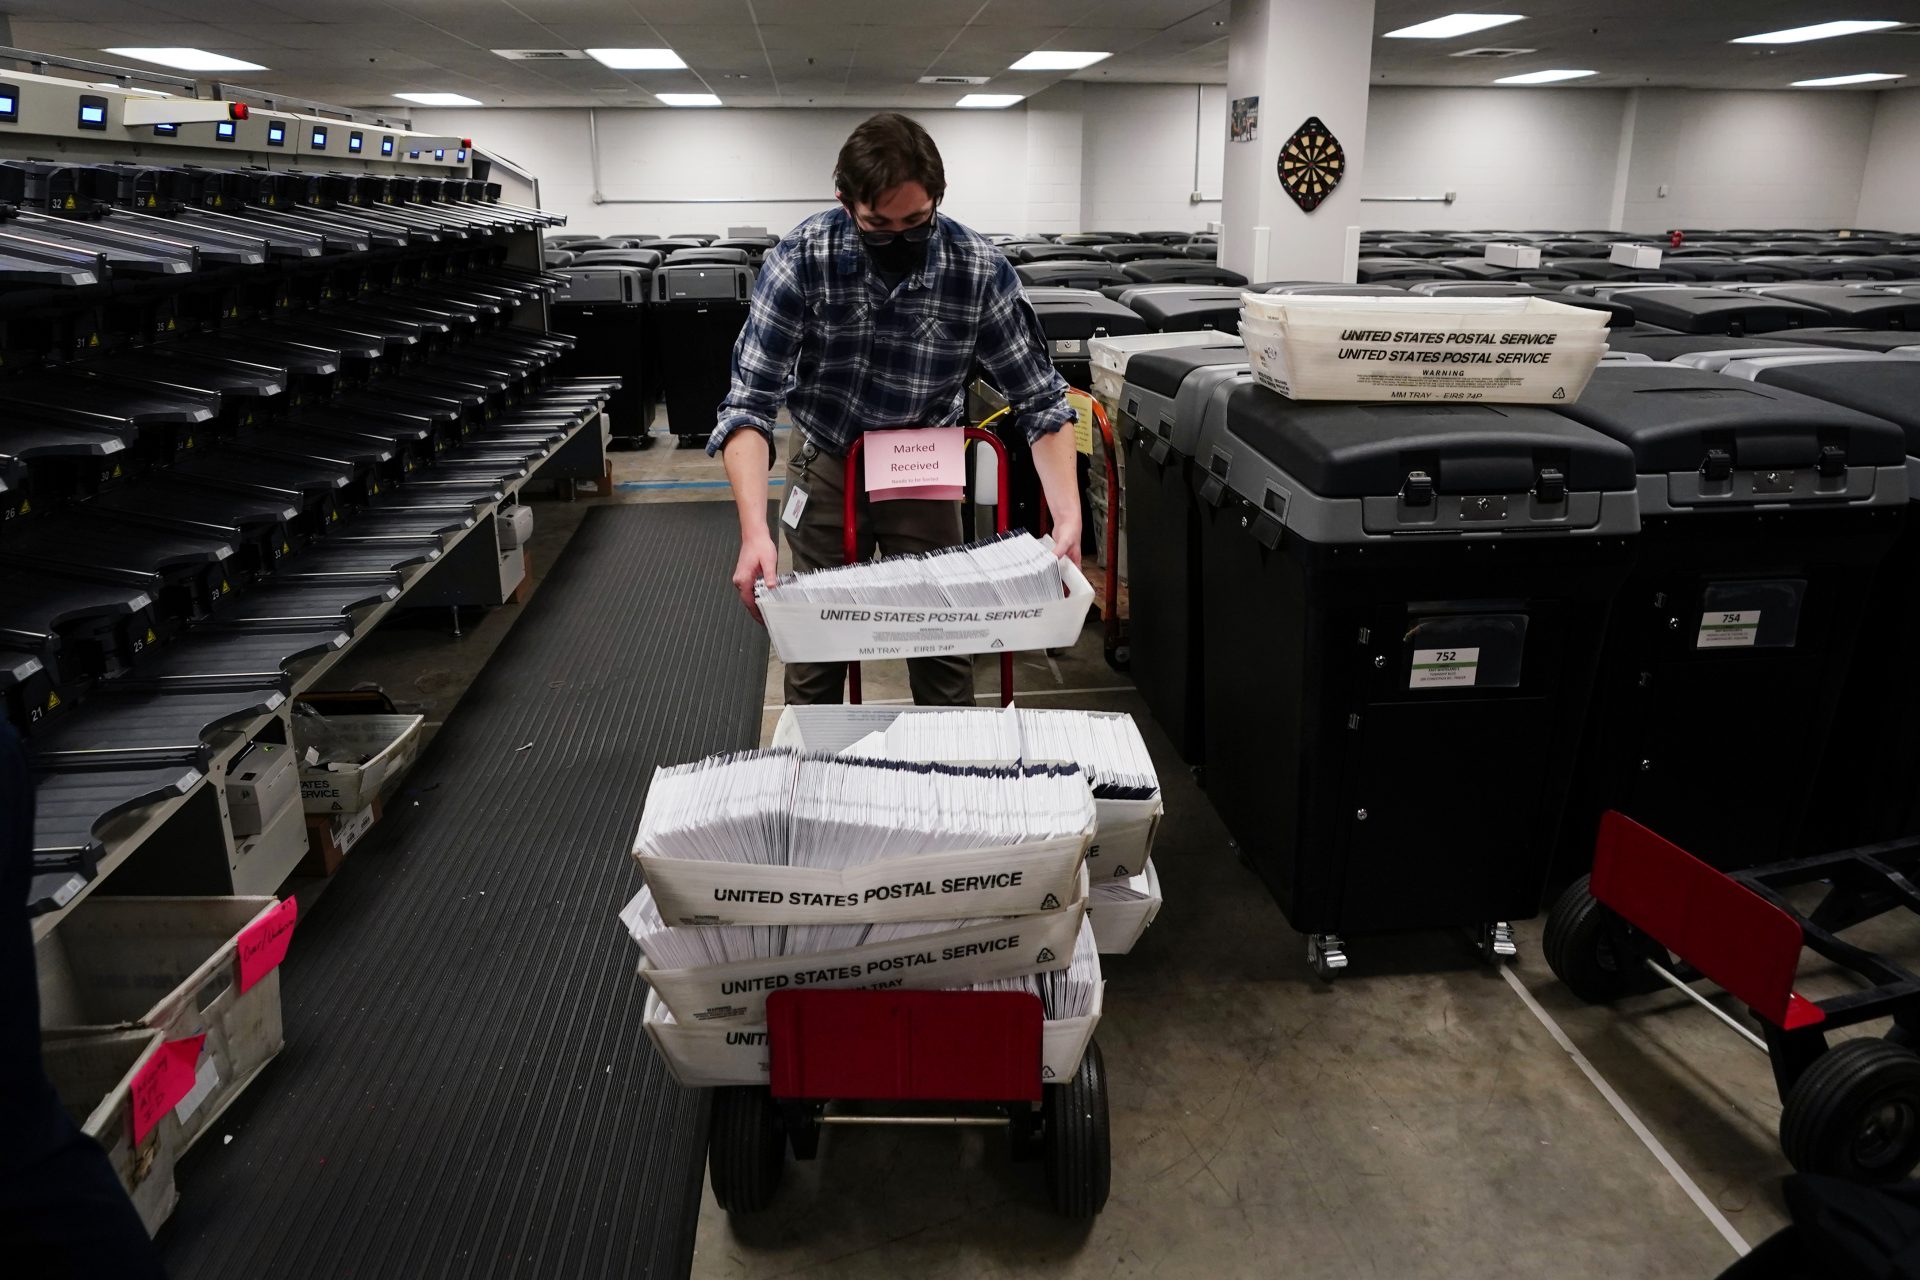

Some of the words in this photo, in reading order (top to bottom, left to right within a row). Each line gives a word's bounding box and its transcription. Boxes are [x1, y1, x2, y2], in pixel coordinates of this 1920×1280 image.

[52, 198, 62, 209] 32
[1341, 329, 1391, 342] UNITED
[1393, 332, 1444, 344] STATES
[1446, 333, 1497, 344] POSTAL
[1500, 333, 1557, 345] SERVICE
[1338, 348, 1387, 361] UNITED
[1388, 350, 1441, 363] STATES
[1442, 352, 1492, 363] POSTAL
[1496, 353, 1551, 363] SERVICE
[1422, 369, 1465, 377] WARNING
[1391, 391, 1407, 399] MM
[894, 443, 935, 454] Marked
[891, 460, 939, 472] Received
[5, 507, 16, 520] 26
[212, 588, 220, 600] 29
[820, 609, 871, 622] UNITED
[873, 610, 926, 623] STATES
[928, 611, 982, 623] POSTAL
[984, 608, 1044, 621] SERVICE
[1722, 612, 1741, 623] 754
[133, 639, 144, 653] 25
[859, 647, 875, 655] MM
[876, 646, 901, 654] TRAY
[913, 645, 936, 653] EIRS
[1436, 651, 1457, 662] 752
[31, 708, 43, 723] 21
[714, 888, 784, 904] UNITED
[788, 891, 859, 907] STATES
[863, 881, 936, 903] POSTAL
[941, 871, 1023, 893] SERVICE
[721, 974, 789, 995] UNITED
[794, 965, 862, 986] STATES
[866, 953, 937, 975] POSTAL
[941, 935, 1020, 960] SERVICE
[872, 978, 903, 991] TRAY
[726, 1031, 769, 1046] UNIT
